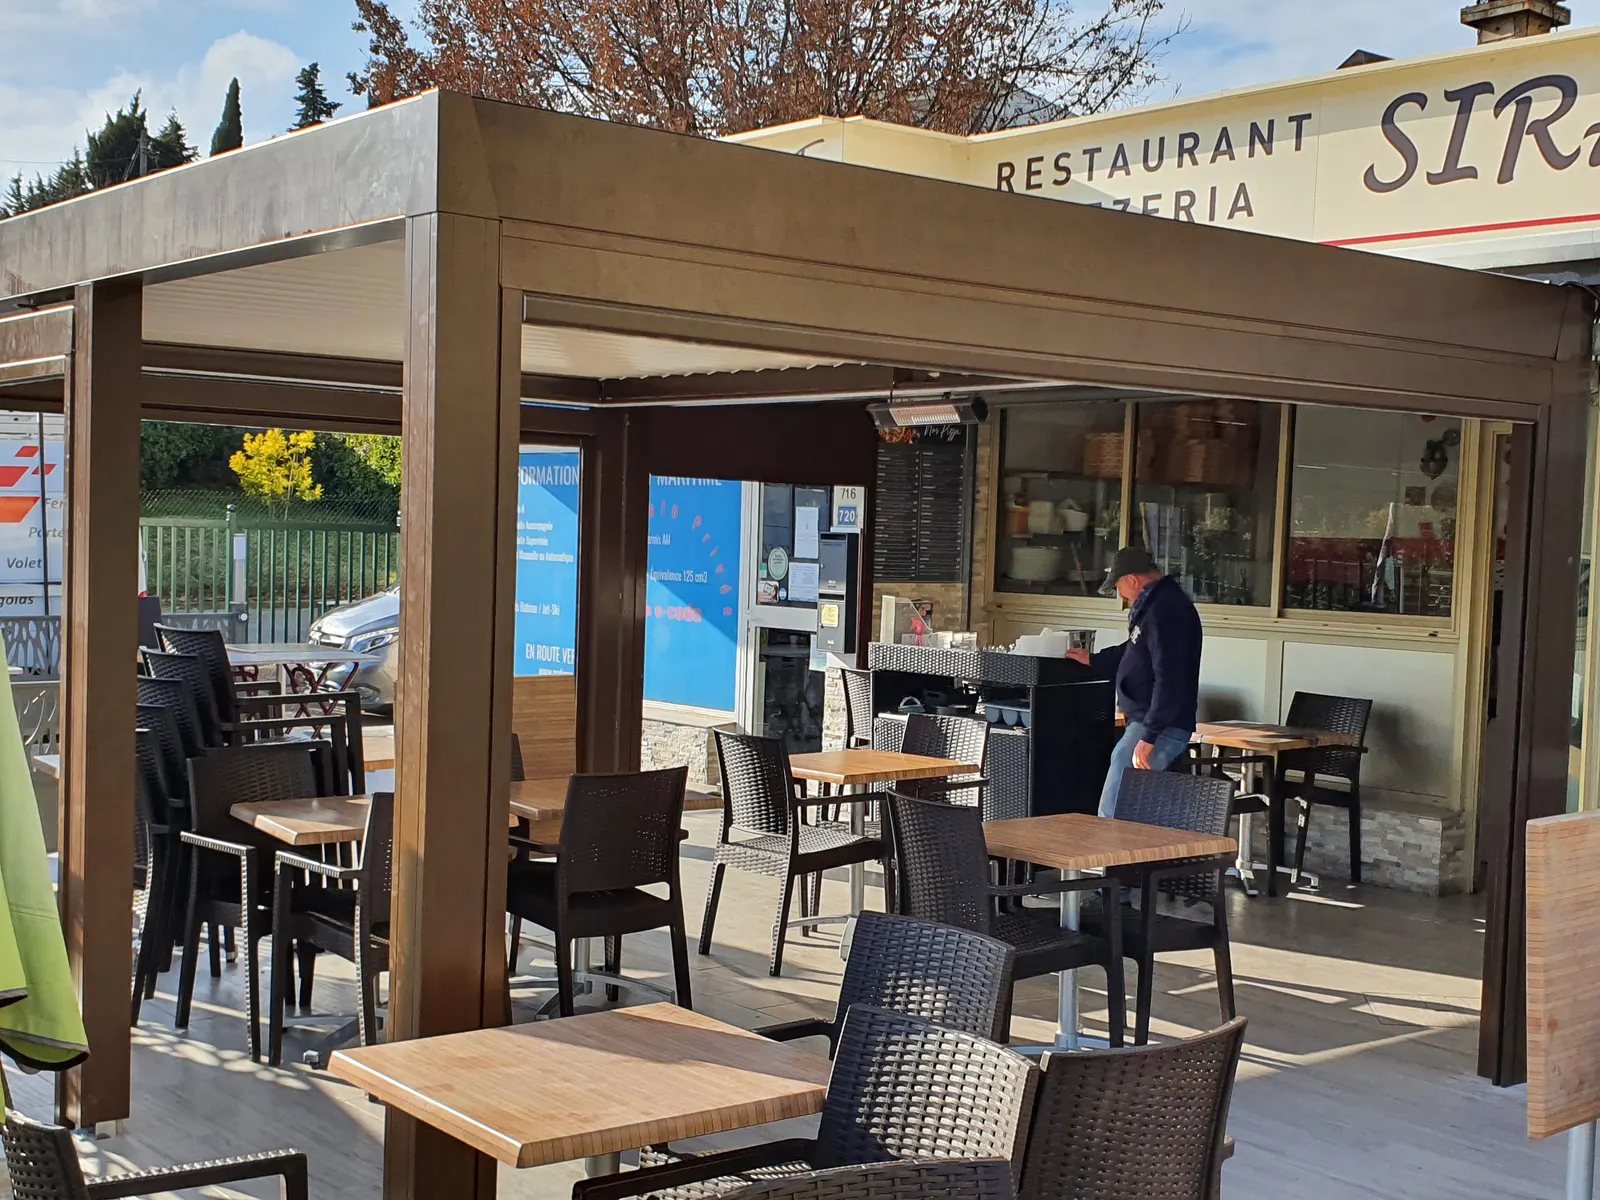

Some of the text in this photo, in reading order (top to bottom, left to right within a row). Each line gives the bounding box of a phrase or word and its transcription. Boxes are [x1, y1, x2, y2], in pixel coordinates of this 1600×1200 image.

[996, 112, 1313, 193] RESTAURANT
[1084, 182, 1255, 224] ERIA
[840, 487, 857, 500] 716
[839, 510, 855, 522] 720
[7, 557, 42, 569] Volet
[683, 570, 694, 583] 125
[525, 643, 535, 659] EN
[536, 644, 560, 663] ROUTE
